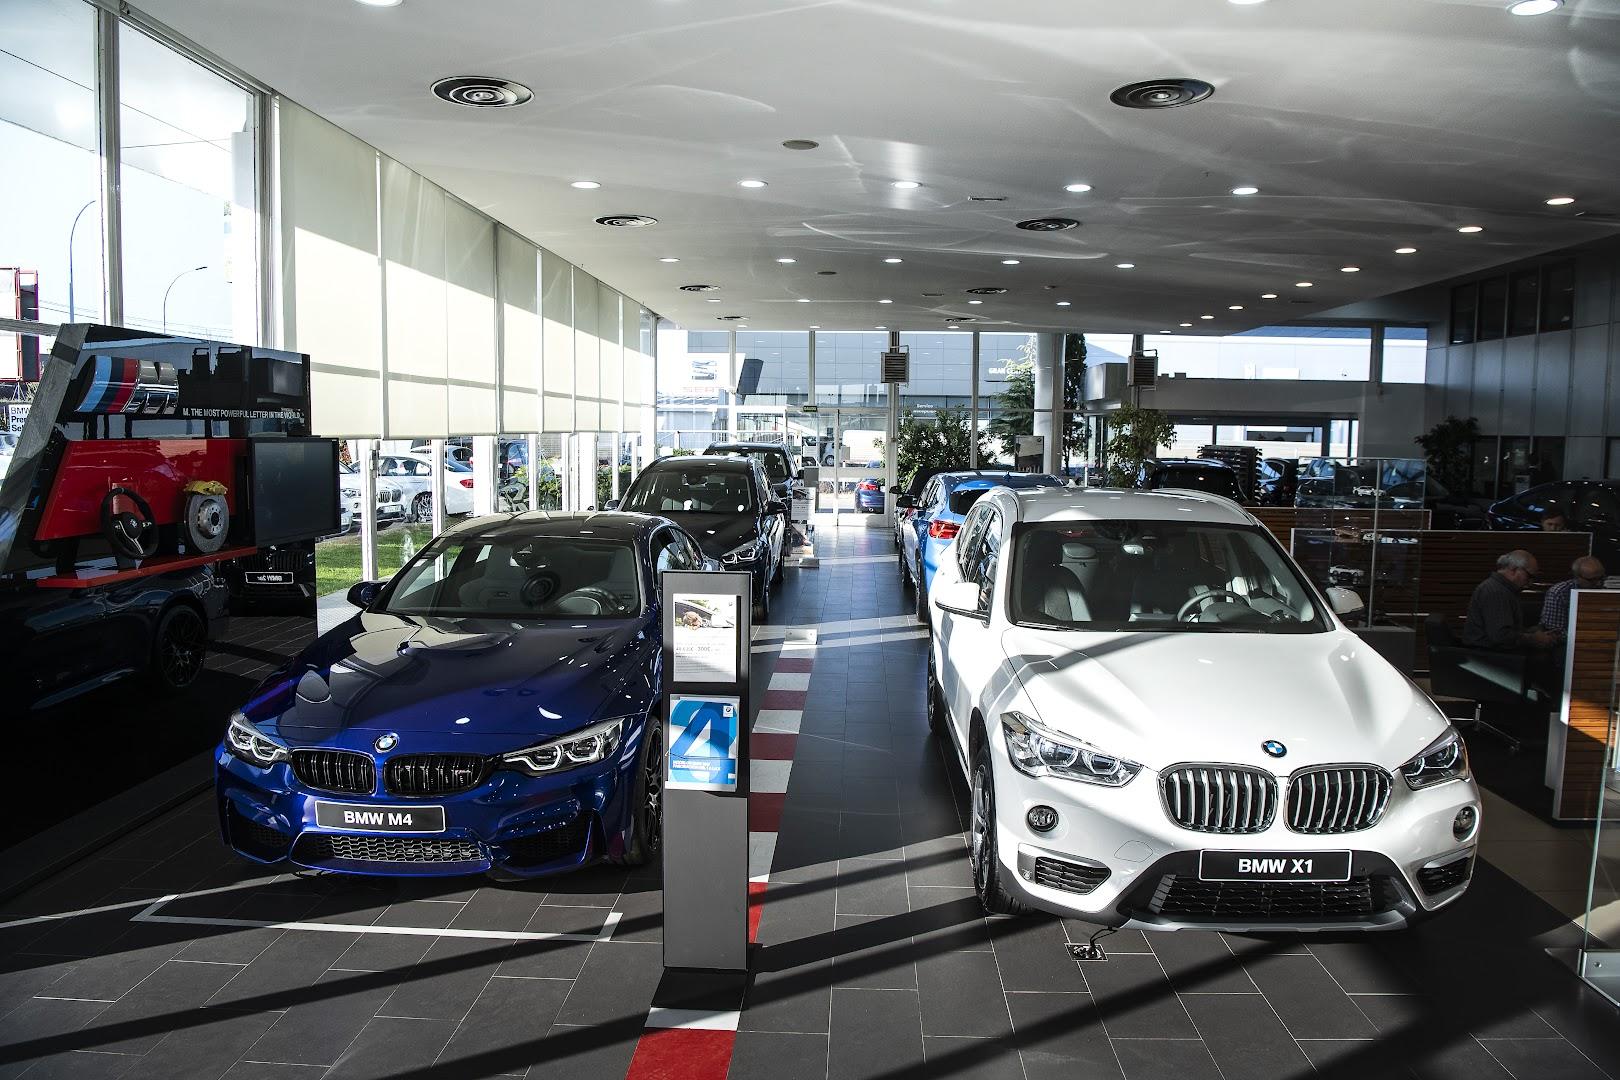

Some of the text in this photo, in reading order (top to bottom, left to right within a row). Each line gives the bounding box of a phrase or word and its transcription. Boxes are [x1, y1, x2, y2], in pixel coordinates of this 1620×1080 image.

[191, 408, 203, 417] THE
[203, 408, 220, 418] MOST
[220, 409, 249, 418] POWERFUL
[250, 410, 269, 419] LETTER
[269, 411, 275, 419] IN
[275, 411, 284, 419] THE
[343, 810, 413, 826] BMW M4
[1238, 858, 1313, 873] BMW X1
